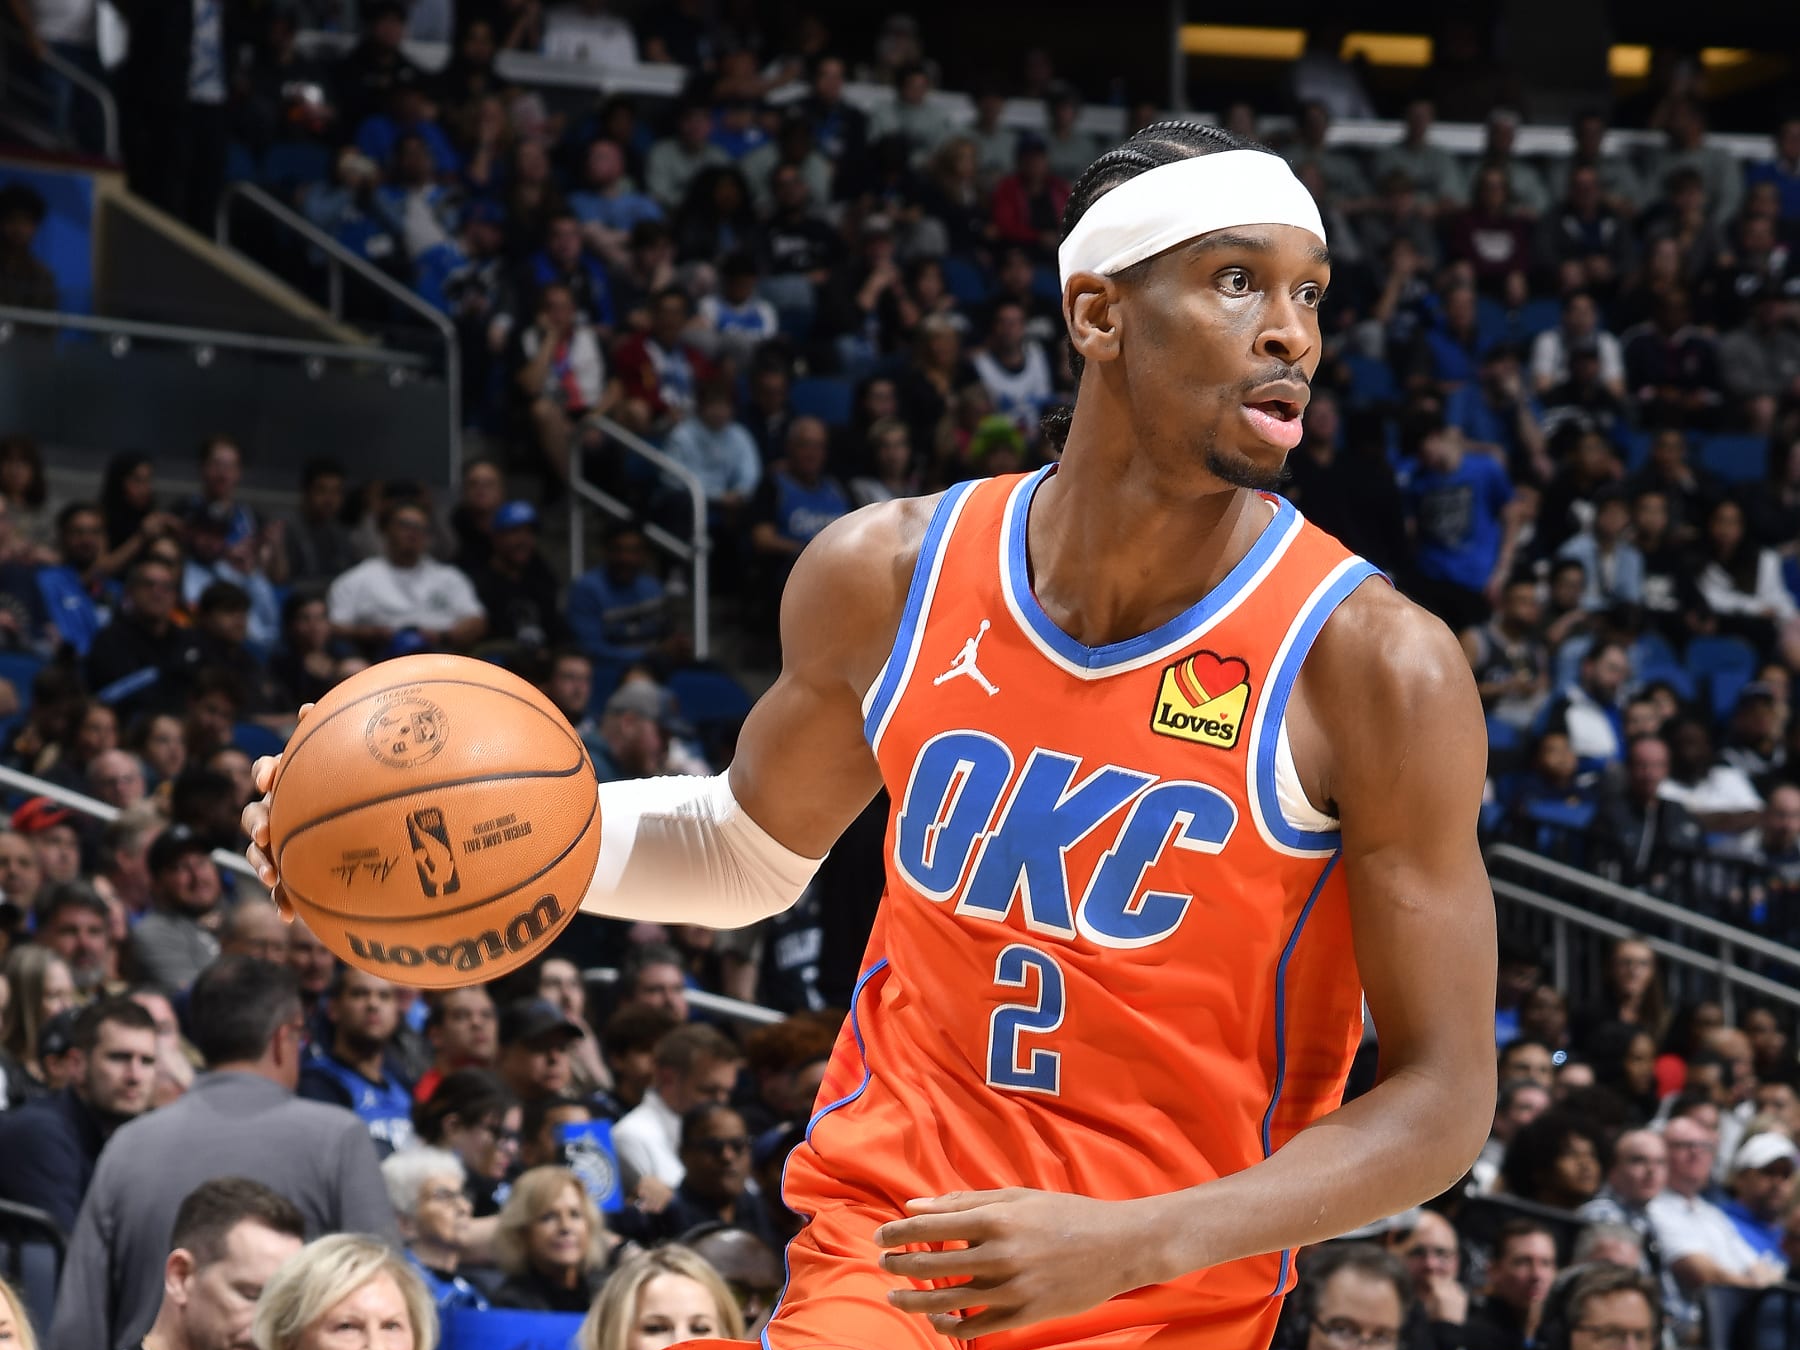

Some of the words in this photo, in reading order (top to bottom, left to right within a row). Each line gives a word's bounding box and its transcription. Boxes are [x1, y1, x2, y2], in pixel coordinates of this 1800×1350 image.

[462, 837, 482, 855] BALL
[481, 831, 503, 850] GAME
[502, 820, 533, 842] OFFICIAL
[893, 728, 1240, 950] OKC
[345, 892, 566, 972] Wilson
[986, 943, 1067, 1097] 2
